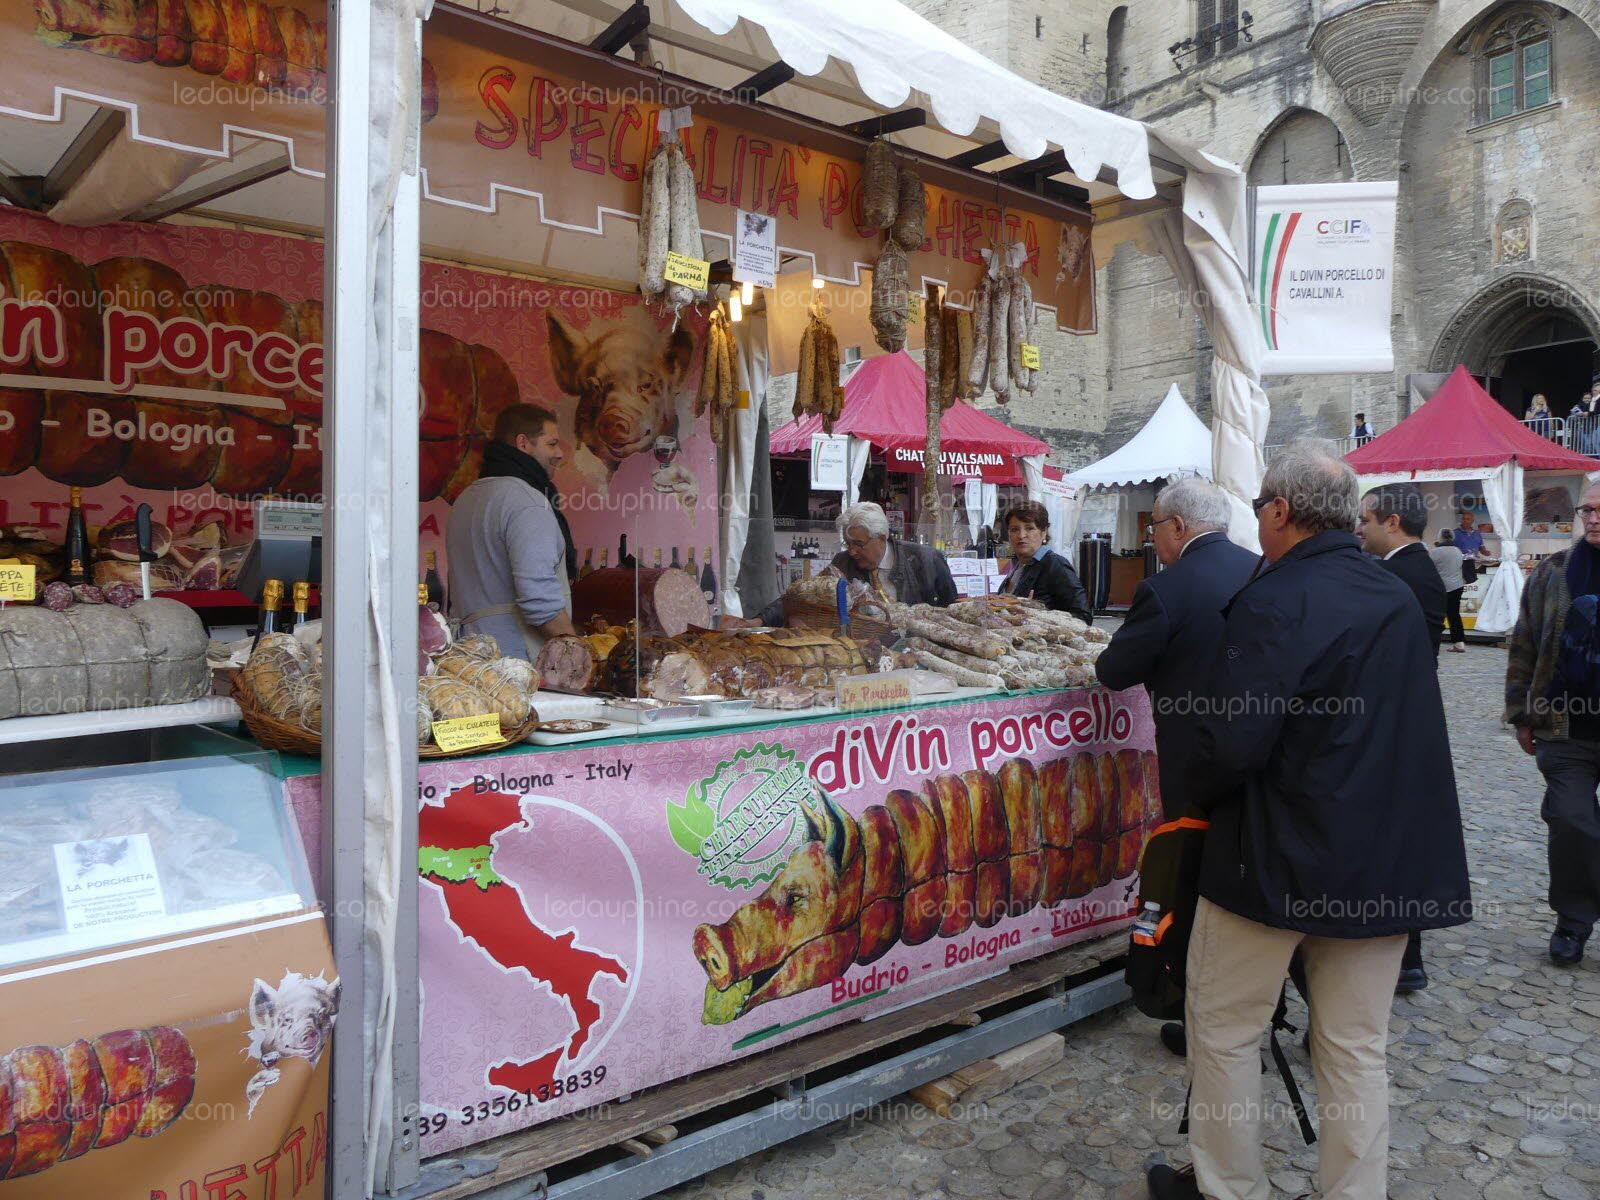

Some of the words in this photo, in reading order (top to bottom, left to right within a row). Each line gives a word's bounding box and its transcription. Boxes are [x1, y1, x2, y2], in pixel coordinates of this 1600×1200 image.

[1300, 270, 1323, 281] DIVIN
[1326, 269, 1373, 281] PORCELLO
[1376, 268, 1385, 280] DI
[87, 408, 236, 451] Bologna
[946, 464, 982, 477] ITALIA
[948, 452, 1004, 466] VALSANIA
[809, 717, 949, 793] diVin
[971, 692, 1131, 770] porcello
[473, 772, 554, 795] Bologna
[584, 759, 633, 781] Italy
[87, 873, 154, 889] PORCHETTA
[830, 961, 908, 1004] Budrio
[944, 926, 1021, 968] Bologna
[1050, 899, 1097, 932] Italy
[460, 1065, 607, 1126] 3356133839
